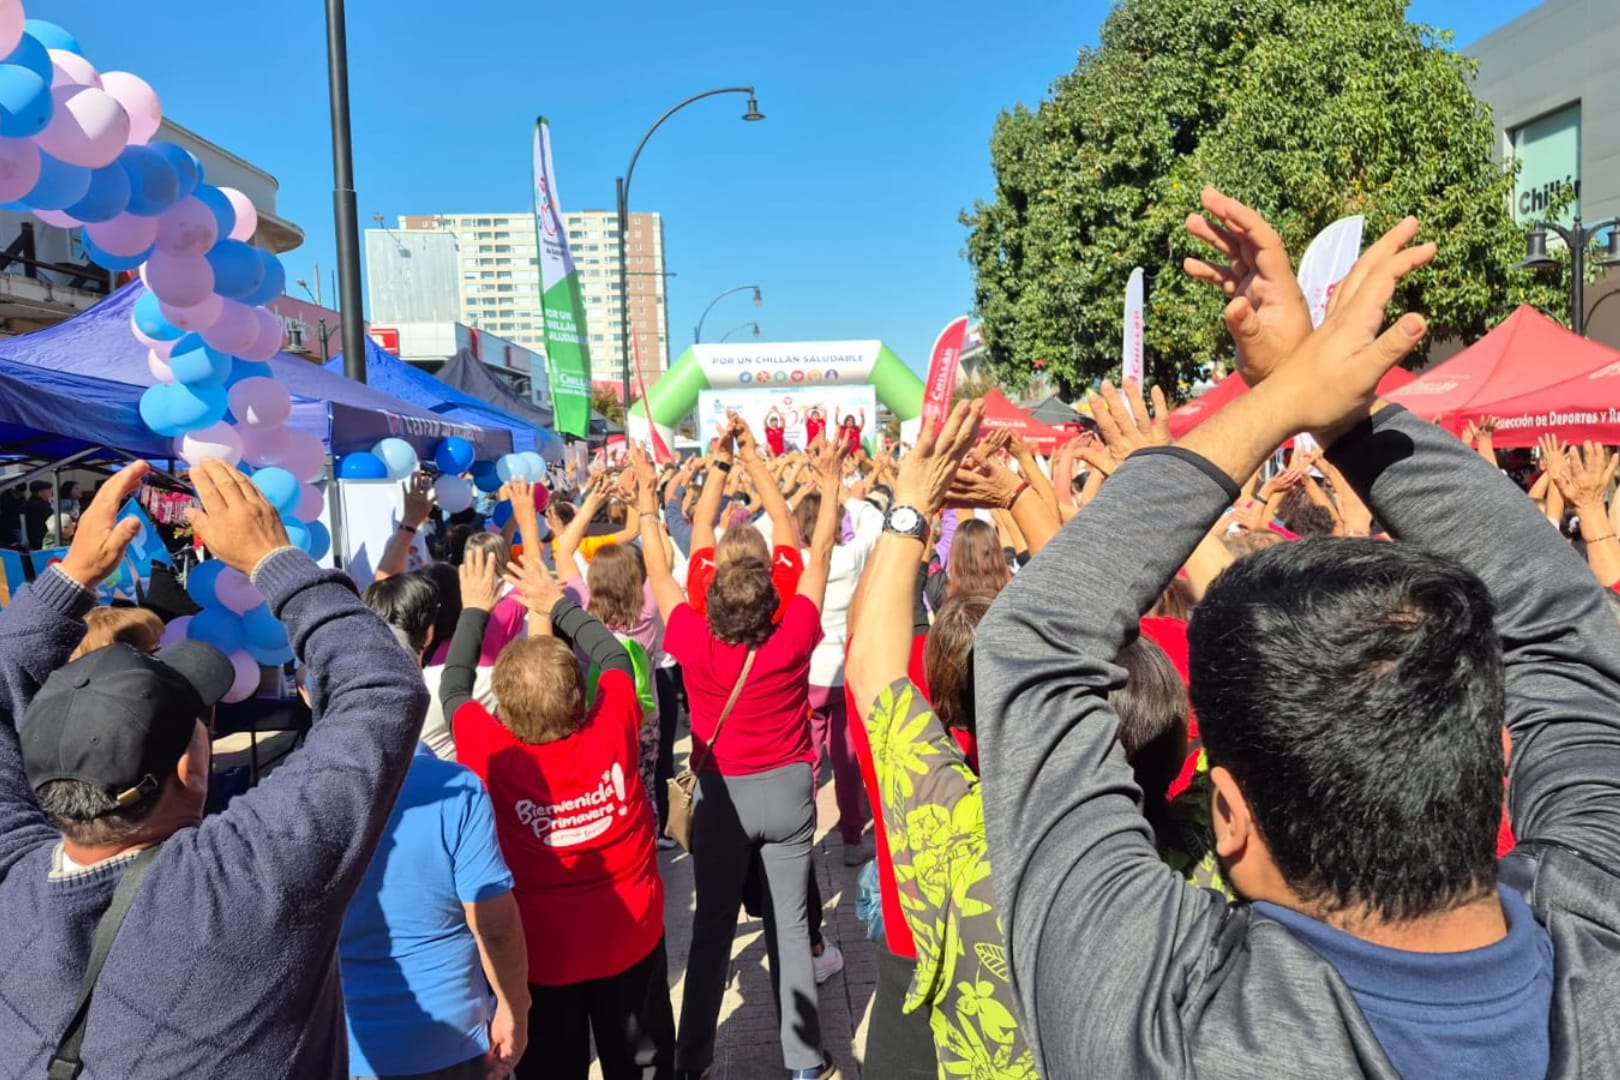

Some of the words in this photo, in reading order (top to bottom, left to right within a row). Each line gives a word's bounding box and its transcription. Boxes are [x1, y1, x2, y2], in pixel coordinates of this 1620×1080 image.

[712, 356, 734, 365] POR
[737, 355, 753, 364] UN
[803, 353, 864, 363] SALUDABLE
